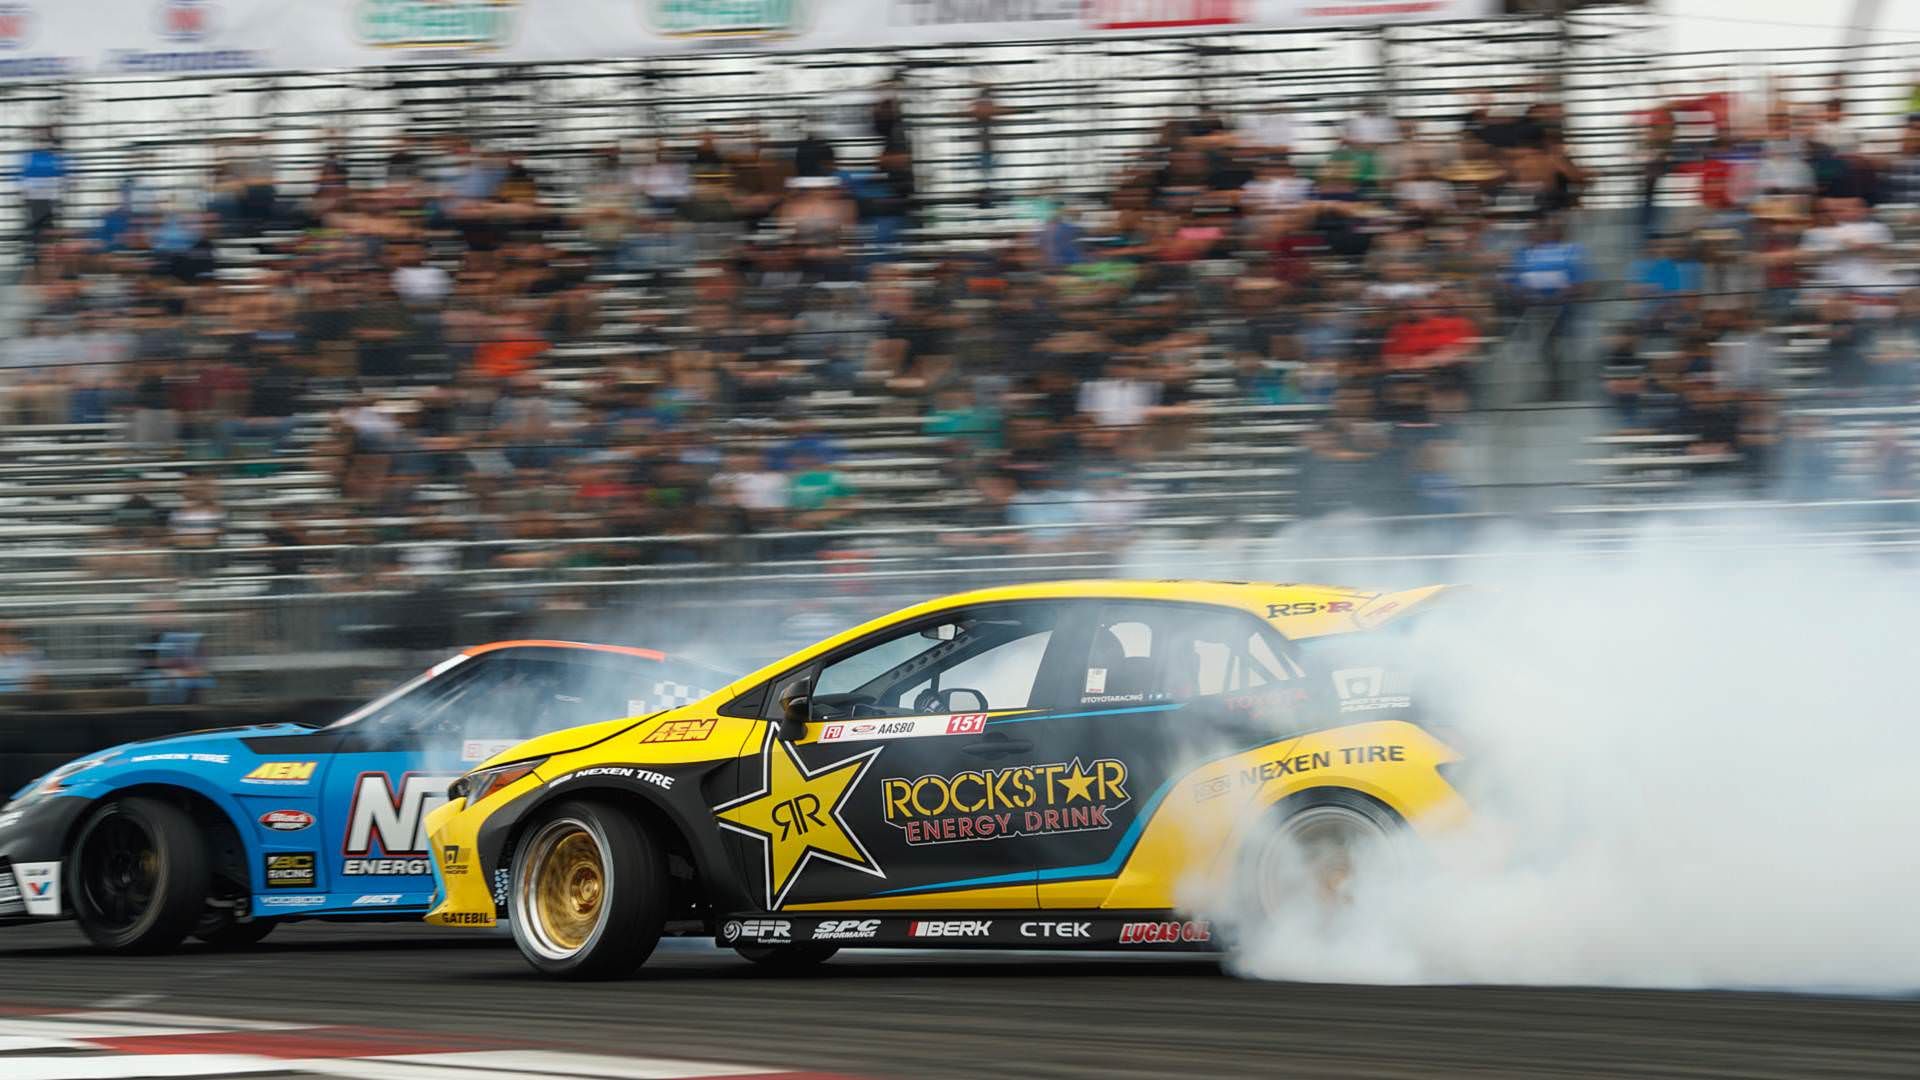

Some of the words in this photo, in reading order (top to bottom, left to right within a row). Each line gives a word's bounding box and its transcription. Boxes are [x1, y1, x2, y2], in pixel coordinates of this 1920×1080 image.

[641, 719, 718, 744] AEM
[878, 721, 915, 734] AASBO
[952, 715, 985, 731] 151
[1240, 750, 1330, 785] NEXEN
[1339, 745, 1406, 765] TIRE
[575, 767, 633, 778] NEXEN
[635, 770, 675, 790] TIRE
[908, 813, 1011, 842] ENERGY
[1024, 804, 1107, 832] DRINK
[442, 912, 490, 924] GATEBIL
[814, 919, 882, 933] SPC
[741, 919, 791, 937] EFR
[812, 931, 876, 940] PERFORMANCE
[926, 920, 992, 937] BERK
[1019, 922, 1091, 938] CTEK
[1120, 921, 1181, 943] LUCAS
